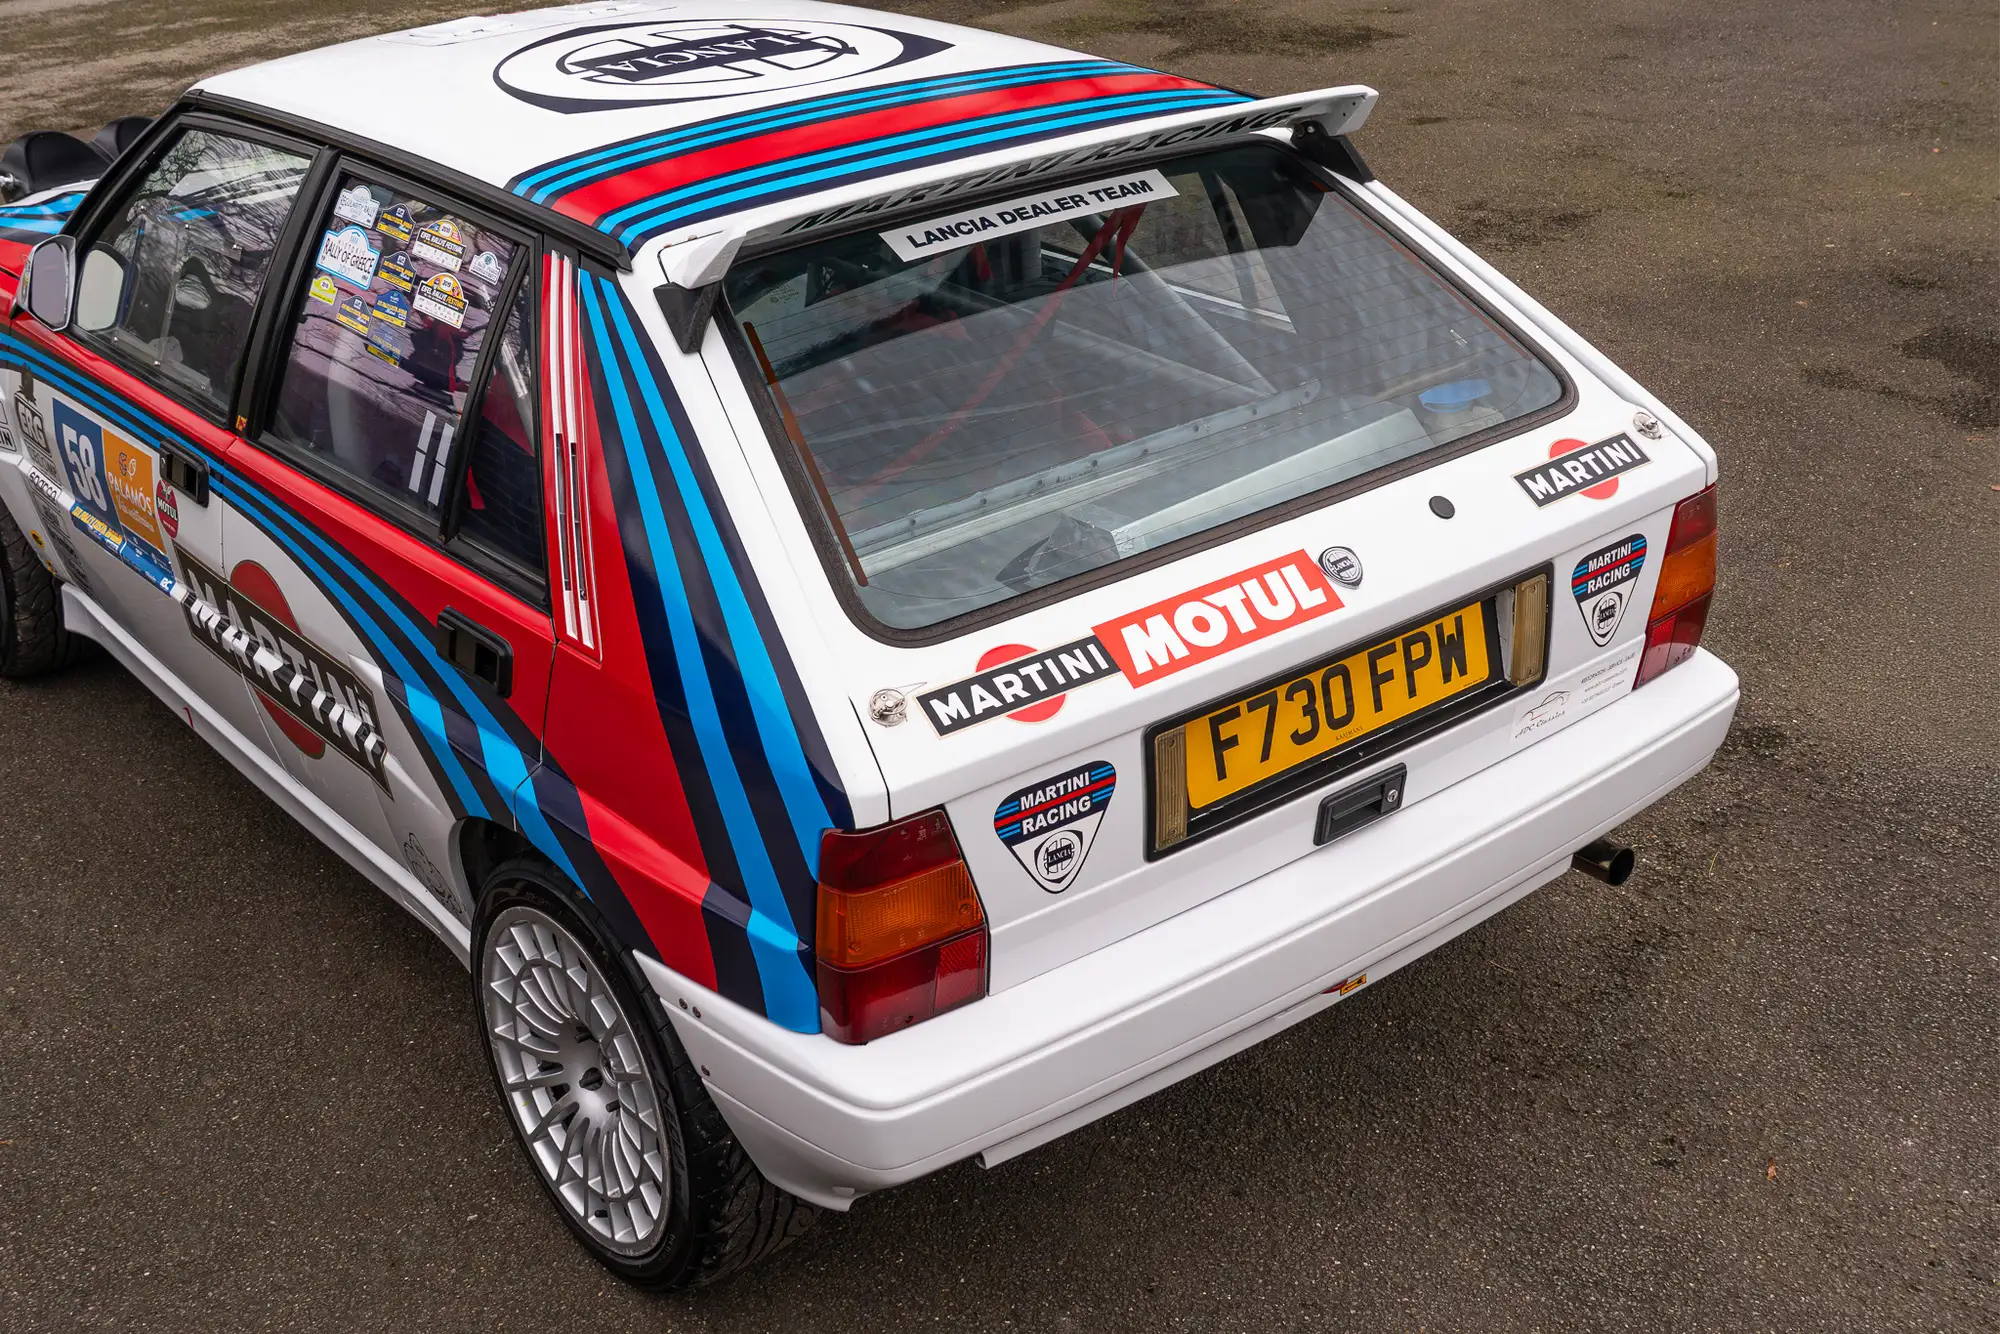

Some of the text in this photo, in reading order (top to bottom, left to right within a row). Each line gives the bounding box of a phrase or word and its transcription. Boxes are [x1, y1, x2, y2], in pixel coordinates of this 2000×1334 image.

[596, 34, 802, 73] LANCIA
[780, 106, 1302, 236] MARTINI RACING
[906, 179, 1154, 249] LANCIA DEALER TEAM
[322, 237, 343, 260] RALLY
[341, 251, 352, 265] OF
[350, 253, 376, 275] GREECE
[446, 296, 465, 309] FESTIVAL
[62, 423, 108, 512] 58
[1522, 438, 1642, 501] MARTINI
[107, 471, 155, 516] PALAMÓS
[157, 499, 179, 521] MOTUL
[1331, 558, 1353, 573] LANCIA
[1588, 542, 1632, 573] MARTINI
[1587, 563, 1631, 594] RACING
[1119, 563, 1328, 675] MOTUL
[186, 568, 378, 770] MARTINI
[933, 643, 1109, 727] MARTINI
[1208, 614, 1469, 782] F730 FPW
[1020, 771, 1090, 811] MARTINI
[1022, 795, 1091, 835] RACING
[1048, 847, 1073, 863] LANCIA
